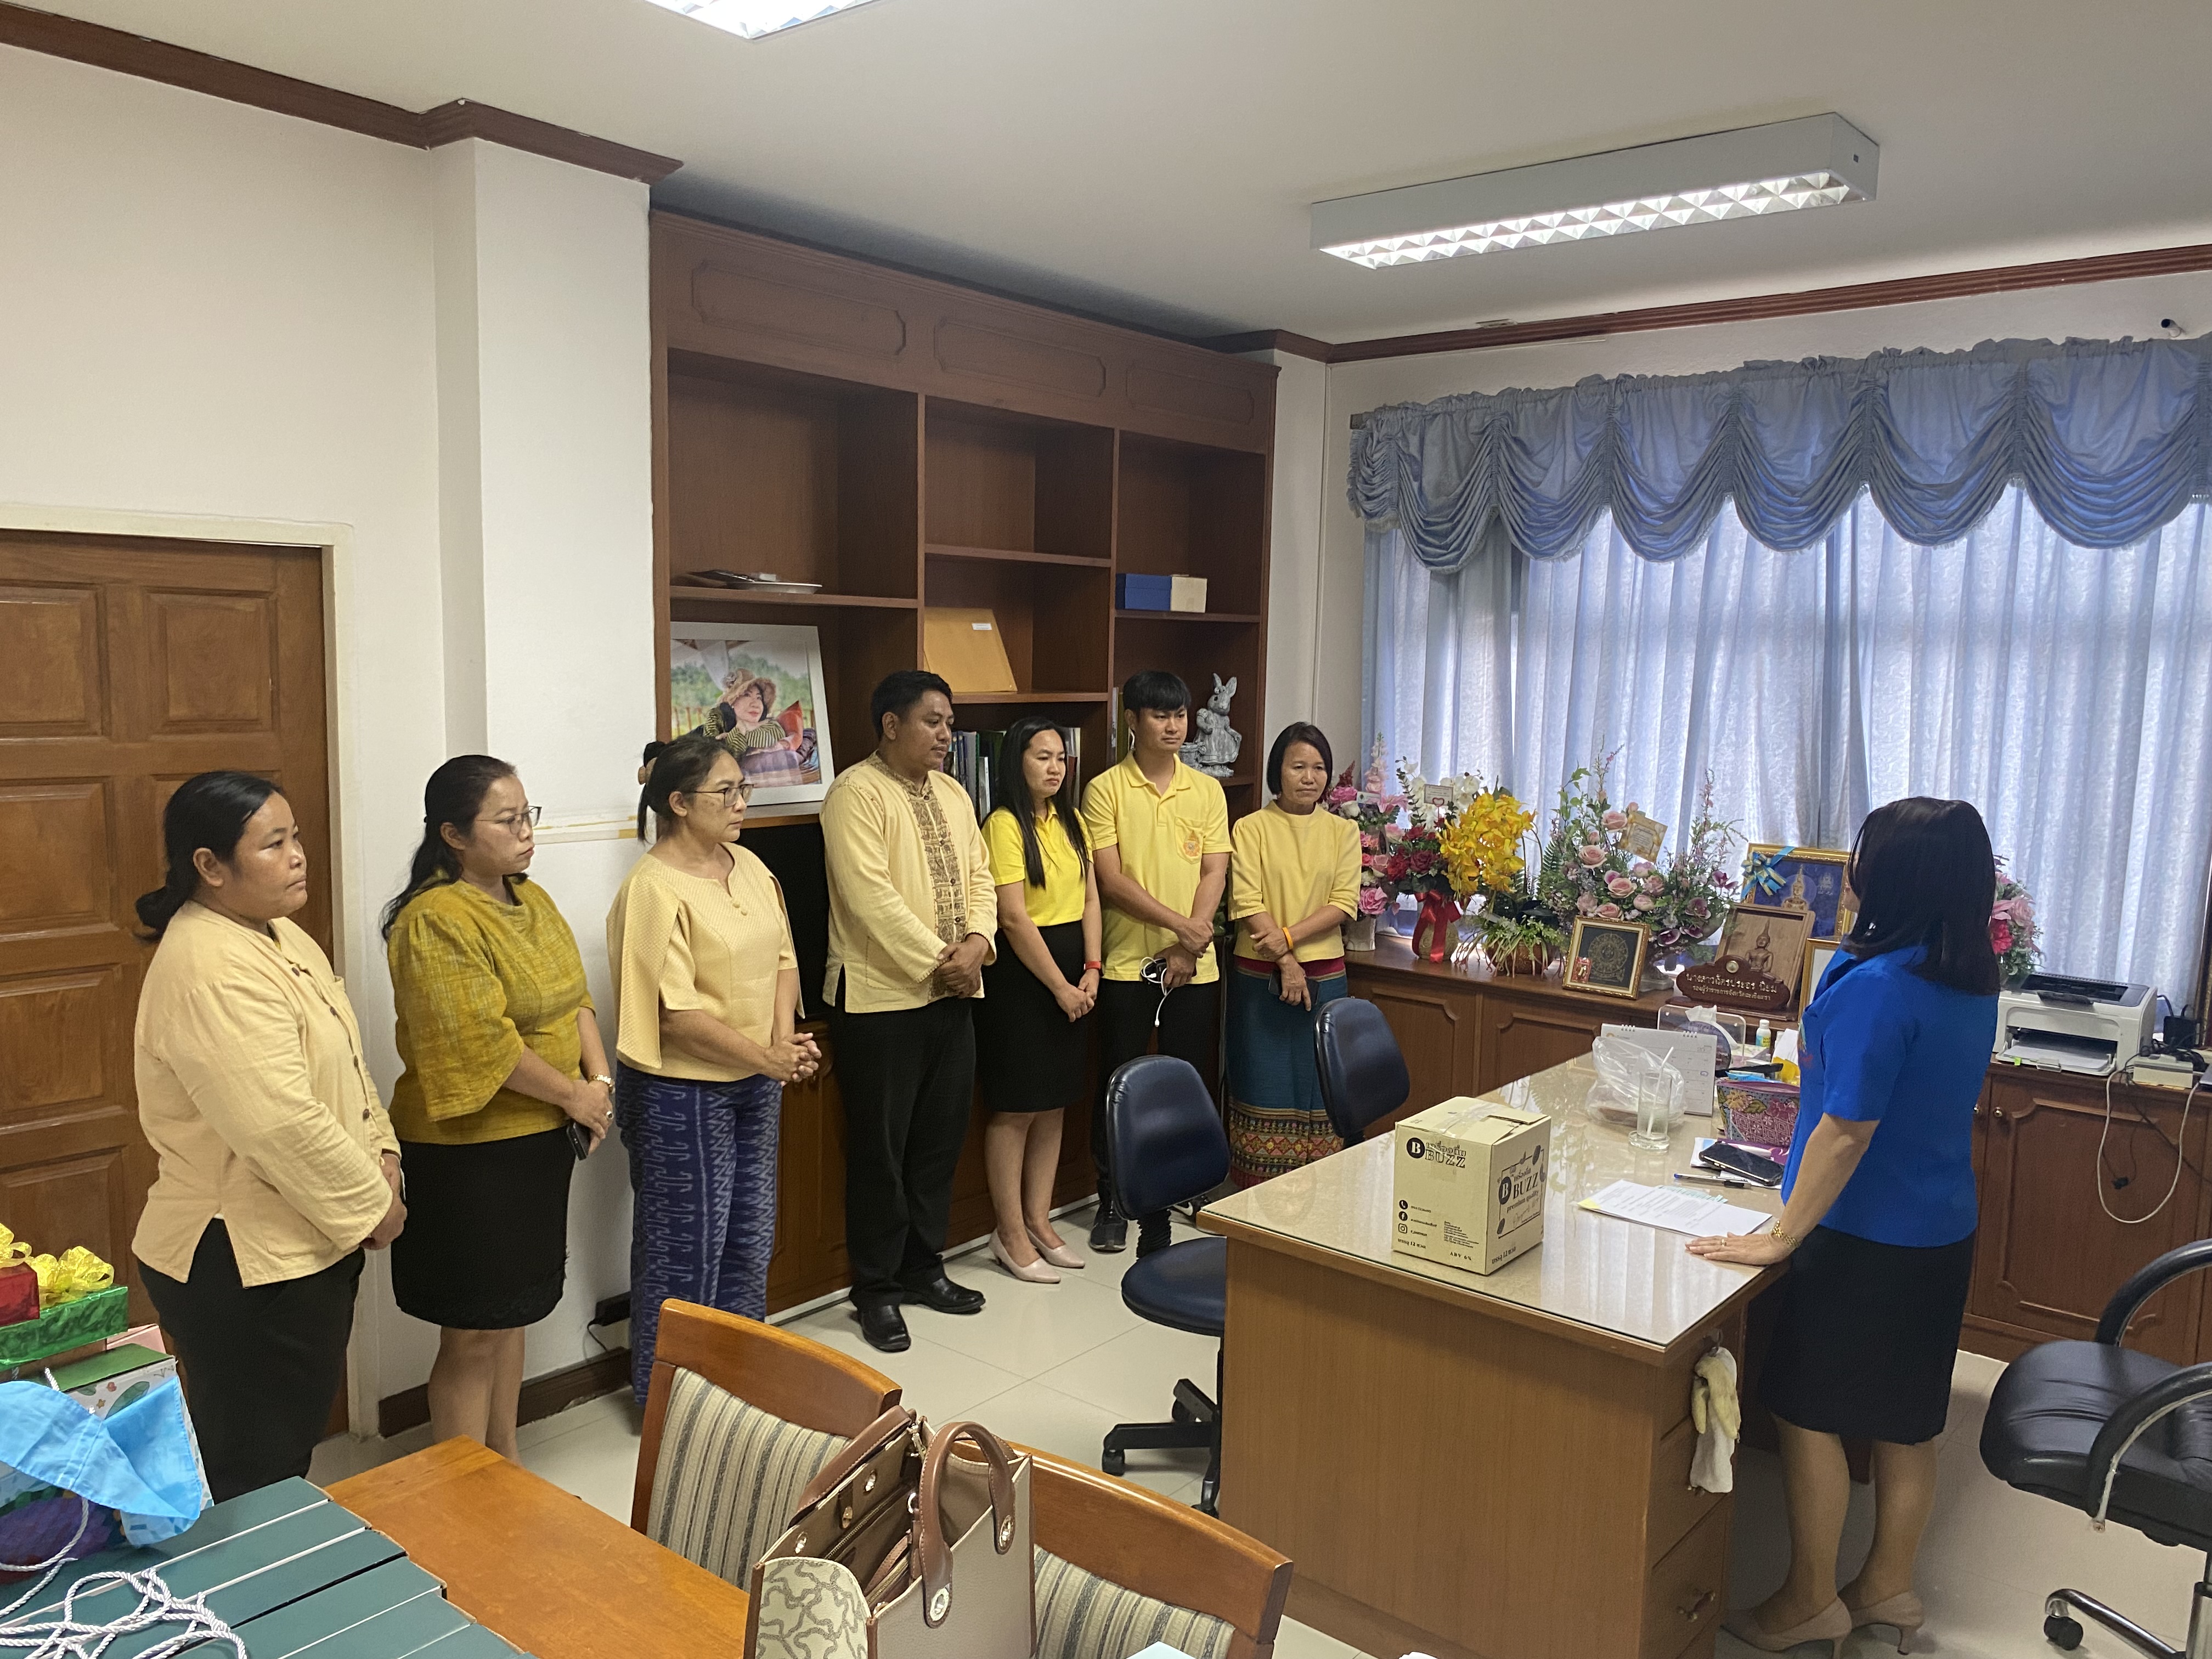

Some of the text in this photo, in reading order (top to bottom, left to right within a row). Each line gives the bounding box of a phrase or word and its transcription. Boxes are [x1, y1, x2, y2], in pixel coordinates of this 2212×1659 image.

[1425, 1149, 1465, 1169] BUZZ
[1513, 1172, 1538, 1200] BUZZ
[1506, 1197, 1526, 1214] premium
